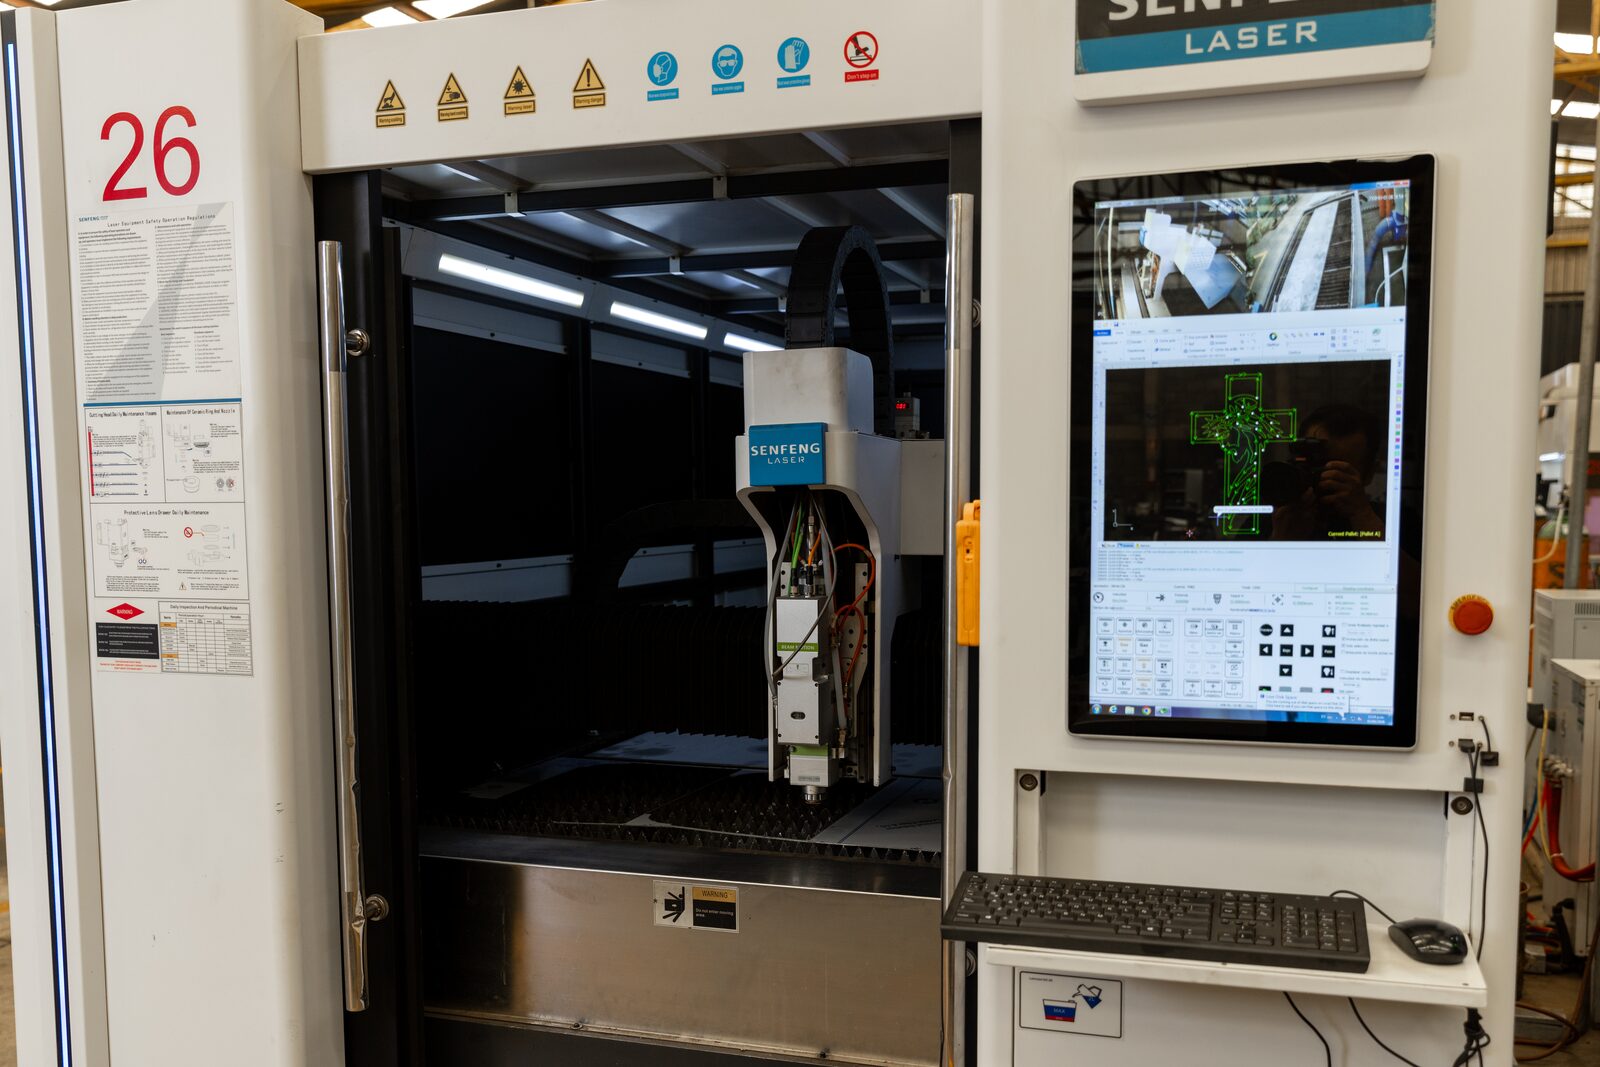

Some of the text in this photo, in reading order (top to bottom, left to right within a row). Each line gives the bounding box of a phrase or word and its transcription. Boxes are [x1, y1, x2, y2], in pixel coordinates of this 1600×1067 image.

[1185, 20, 1318, 55] LASER
[101, 105, 200, 202] 26
[751, 442, 820, 457] SENFENG
[767, 456, 805, 465] LASER
[702, 890, 728, 899] WARNING
